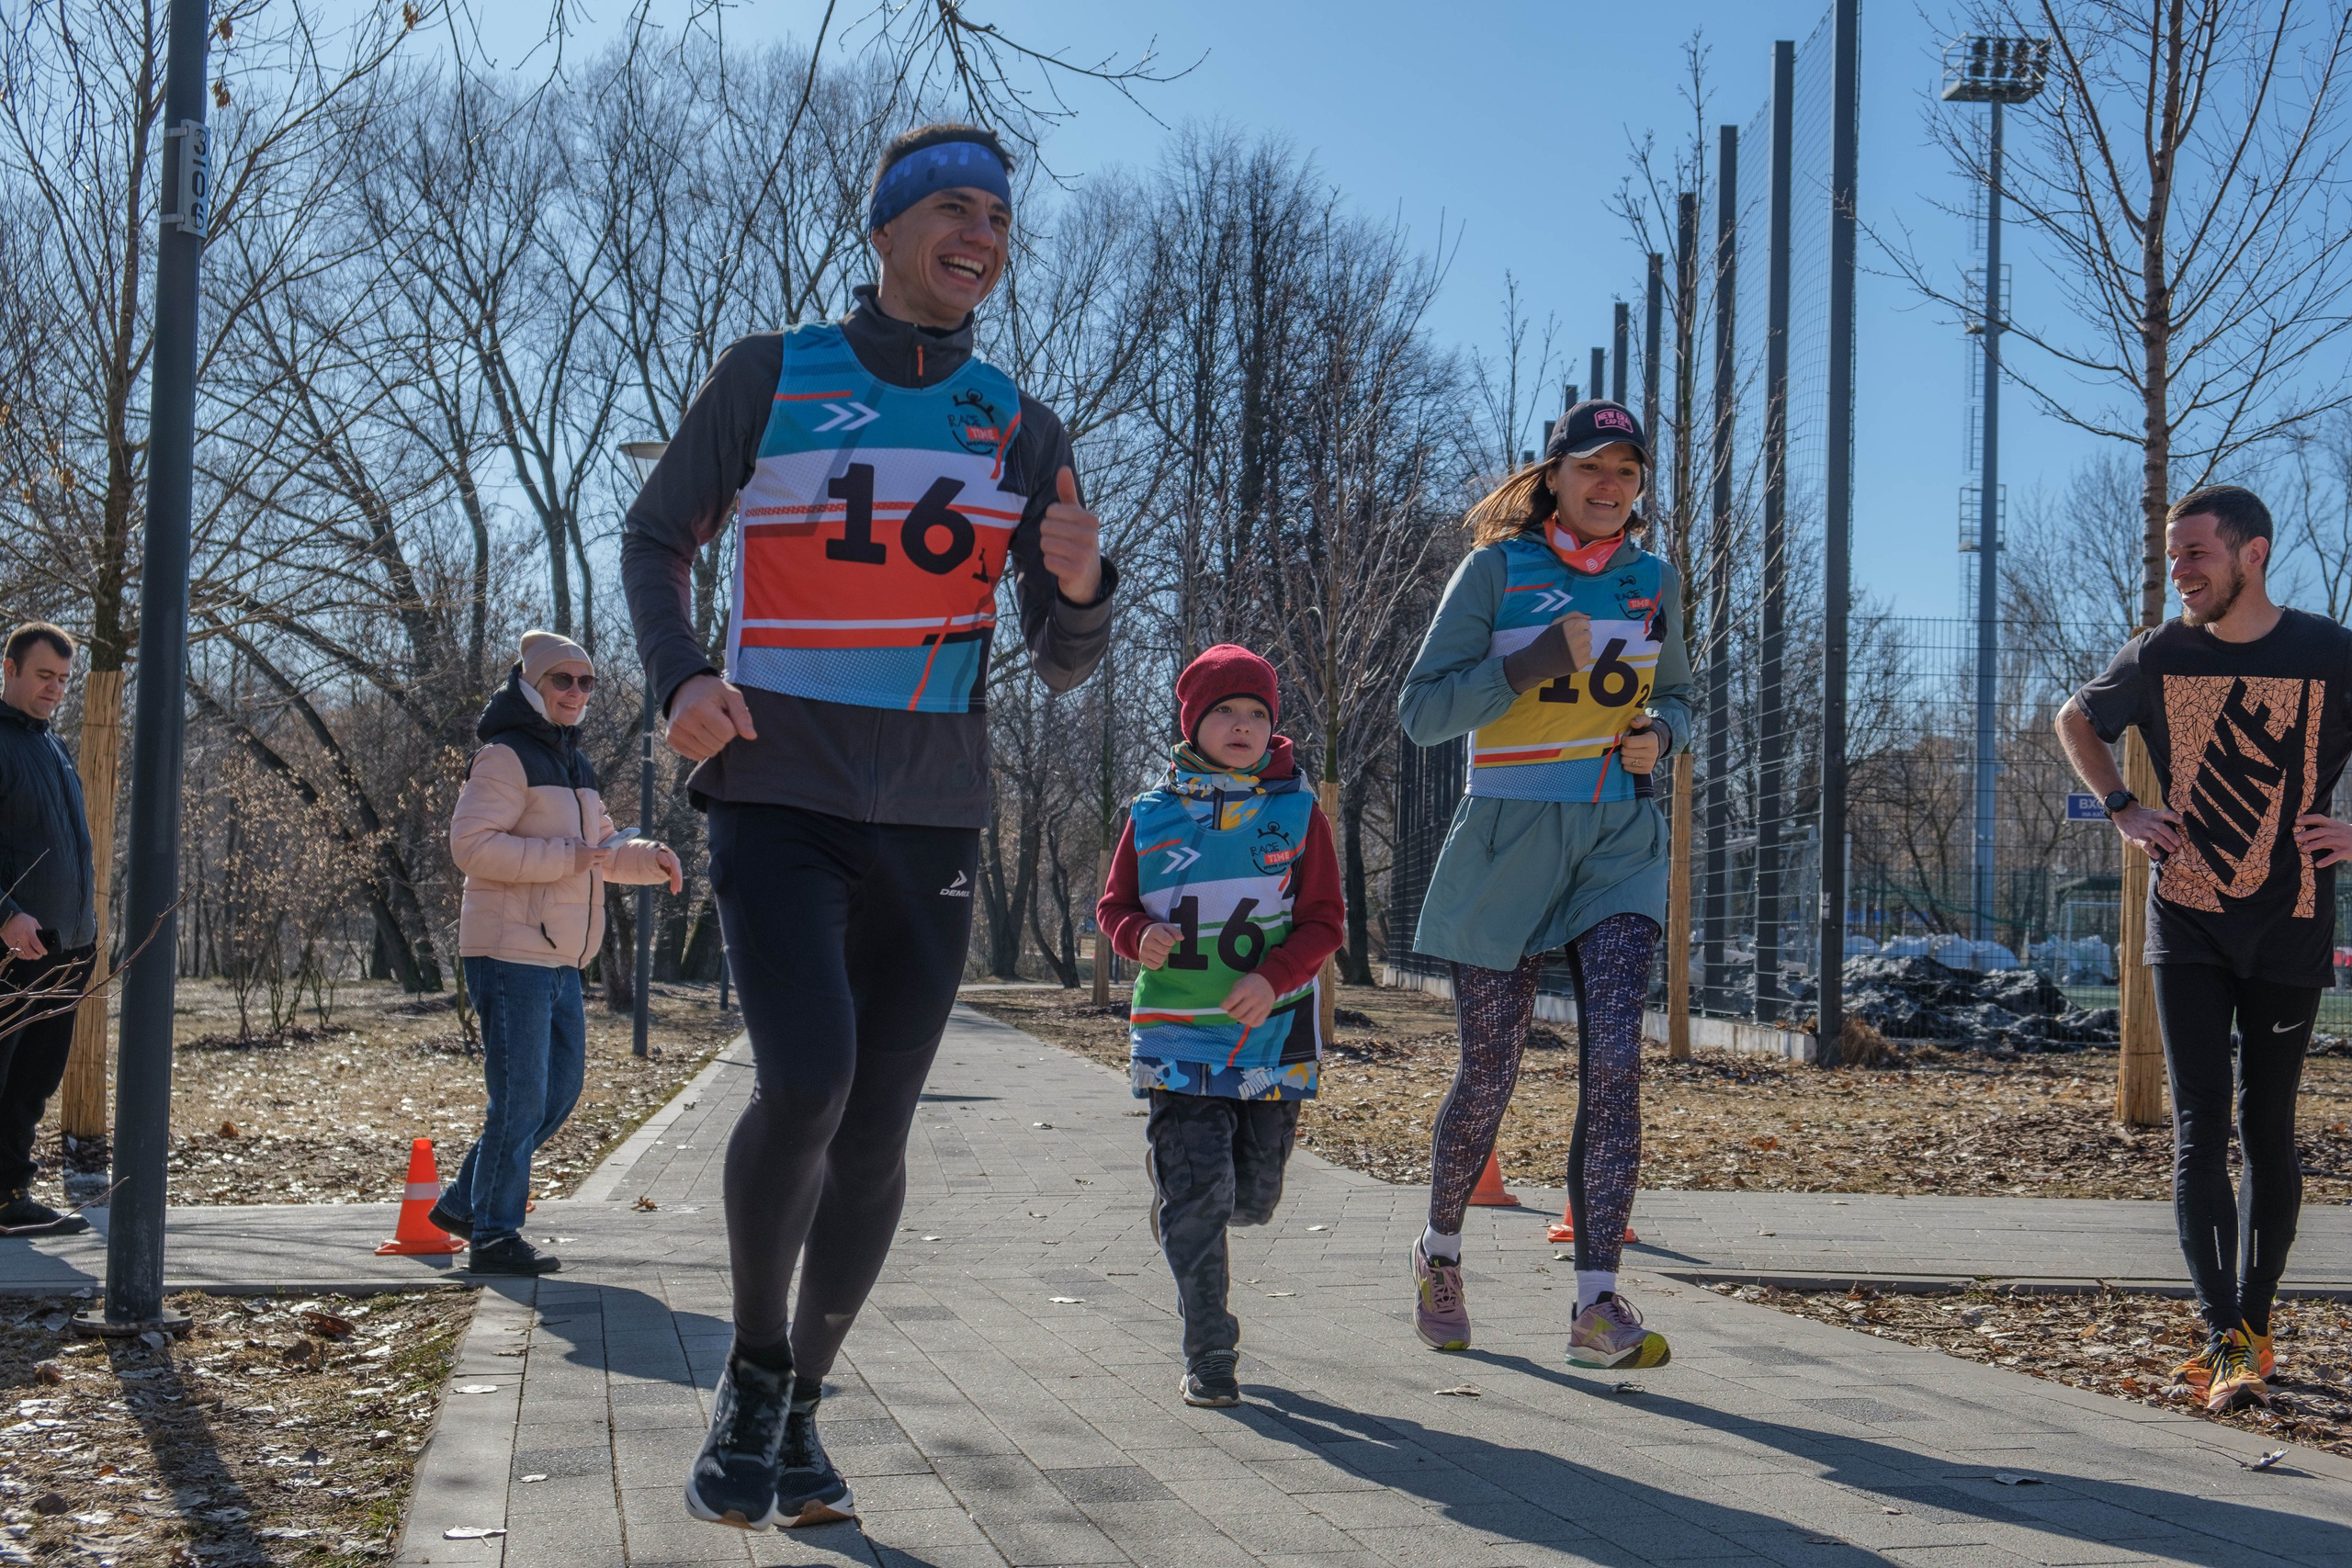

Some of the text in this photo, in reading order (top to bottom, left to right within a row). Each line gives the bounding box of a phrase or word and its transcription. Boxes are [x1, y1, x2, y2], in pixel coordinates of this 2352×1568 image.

[947, 413, 981, 428] RACE
[1598, 411, 1630, 425] NEW ERA
[970, 428, 995, 440] TIME
[825, 462, 976, 575] 16
[1614, 589, 1640, 602] RACE
[1630, 598, 1650, 608] TIME
[2182, 676, 2296, 888] NIKE
[1250, 841, 1280, 857] RACE
[1268, 851, 1290, 863] TIME
[939, 888, 970, 897] DEMIX
[1167, 896, 1265, 973] 16
